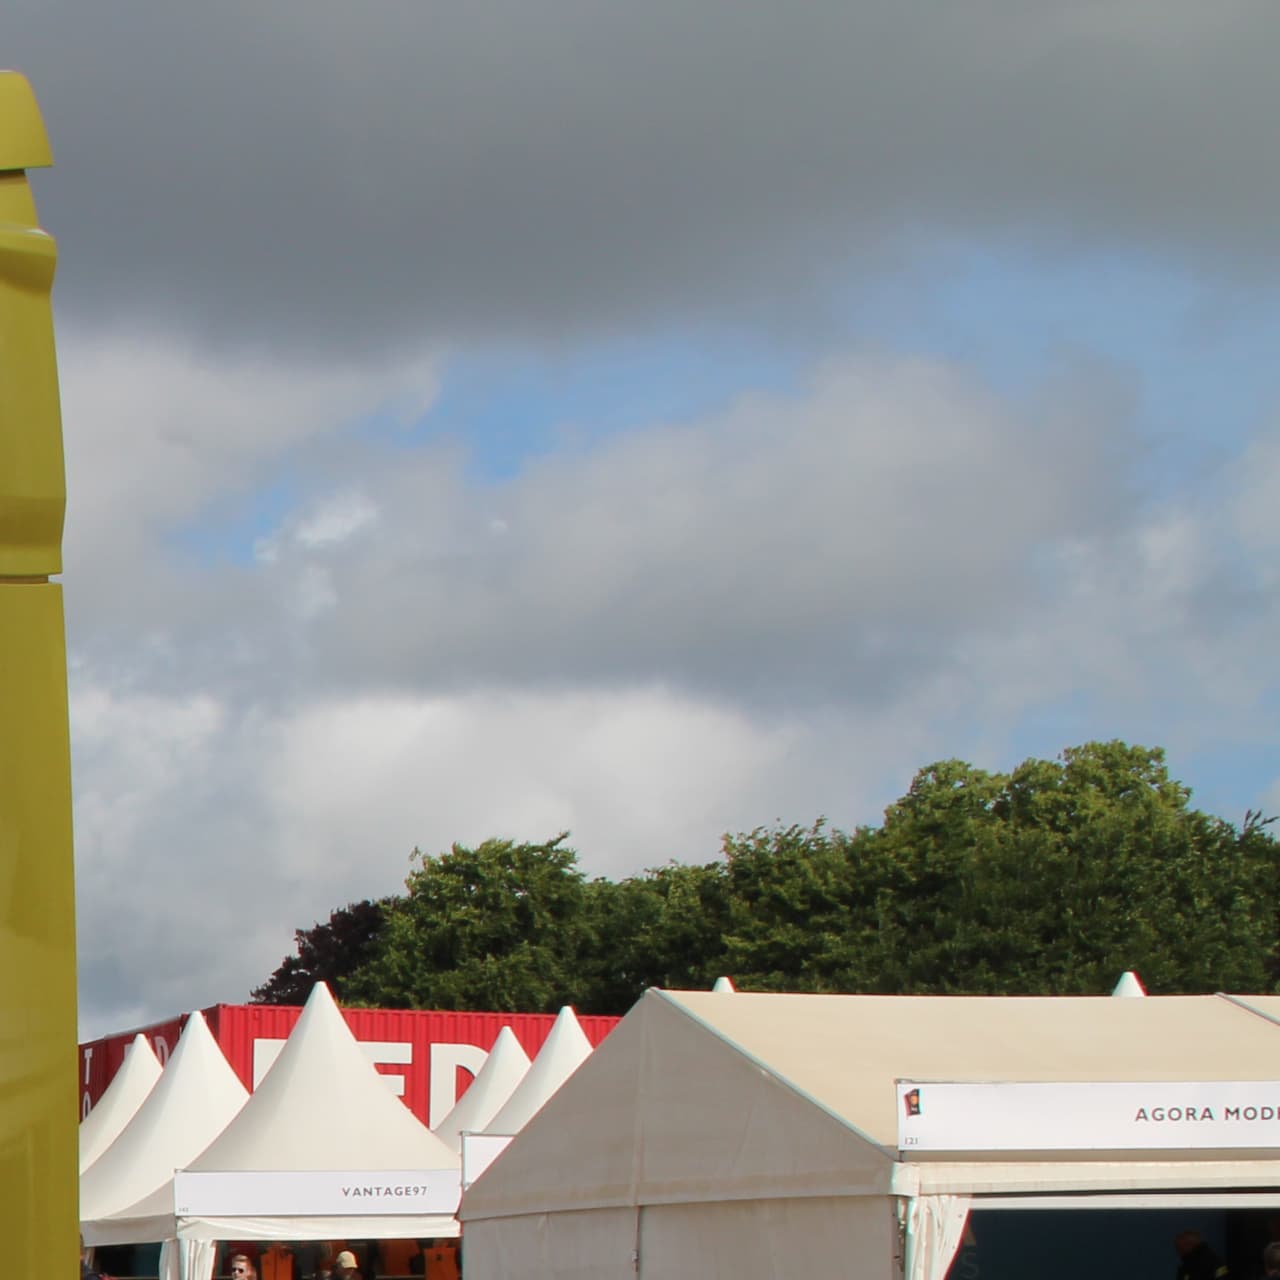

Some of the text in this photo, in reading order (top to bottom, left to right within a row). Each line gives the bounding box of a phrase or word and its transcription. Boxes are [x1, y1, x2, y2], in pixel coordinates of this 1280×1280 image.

[1135, 1106, 1280, 1121] AGORA MOD
[342, 1186, 428, 1198] VANTAGE97
